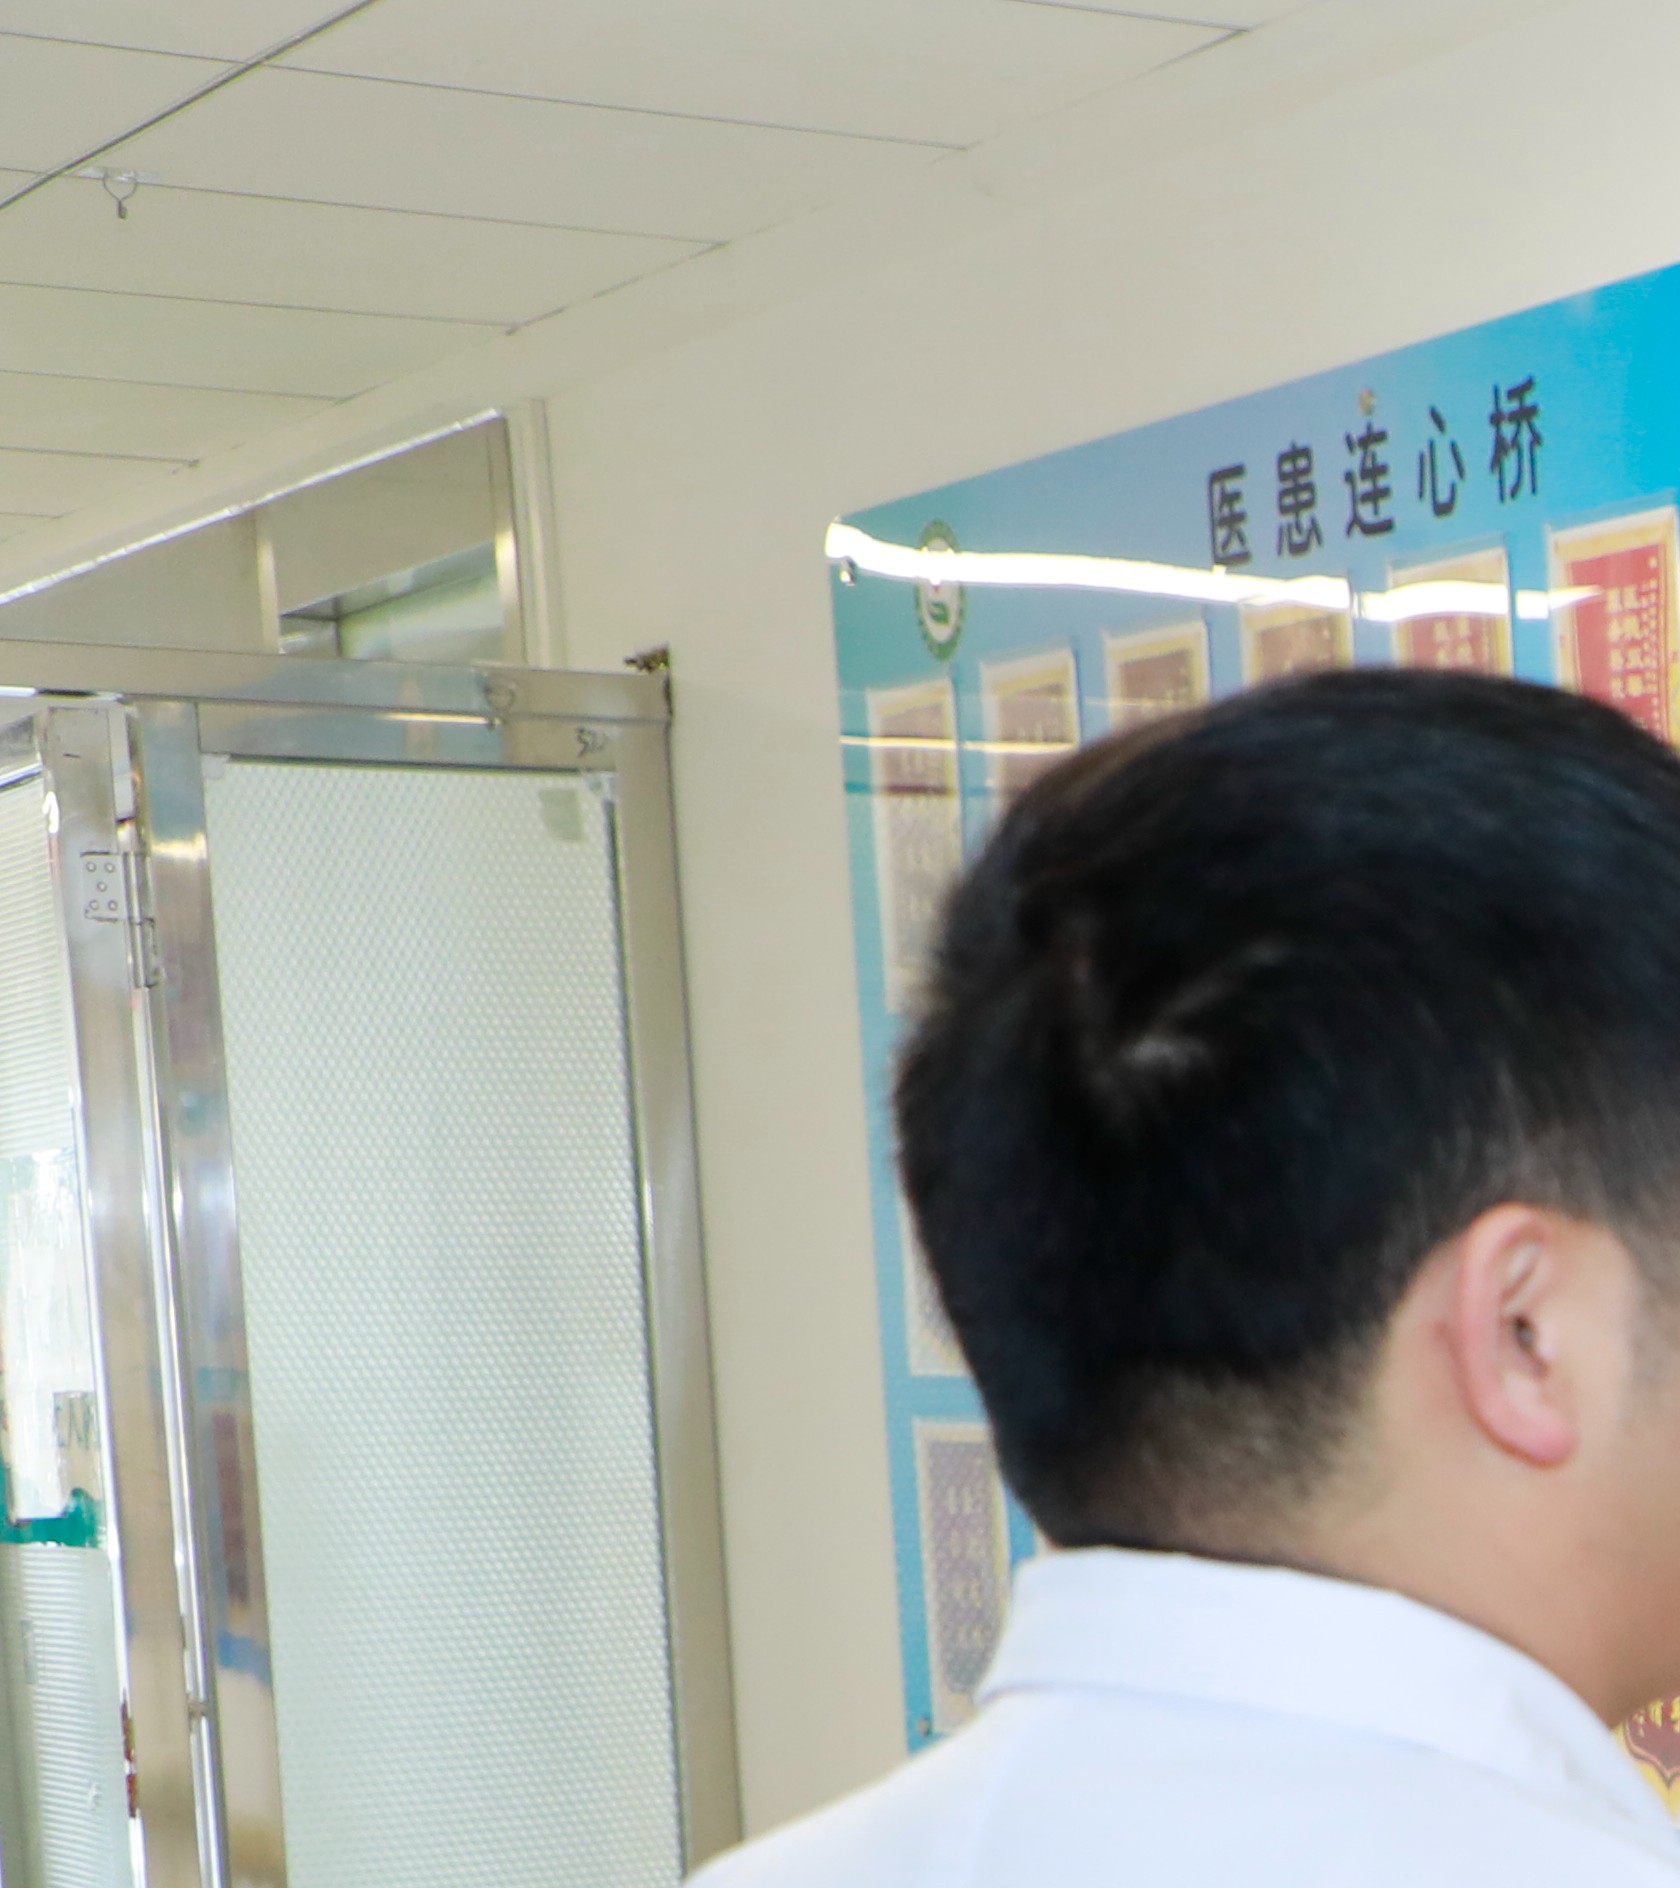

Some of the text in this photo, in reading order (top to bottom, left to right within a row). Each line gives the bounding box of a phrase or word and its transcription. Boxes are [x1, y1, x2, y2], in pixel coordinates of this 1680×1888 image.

[1209, 374, 1543, 566] 医患连心桥
